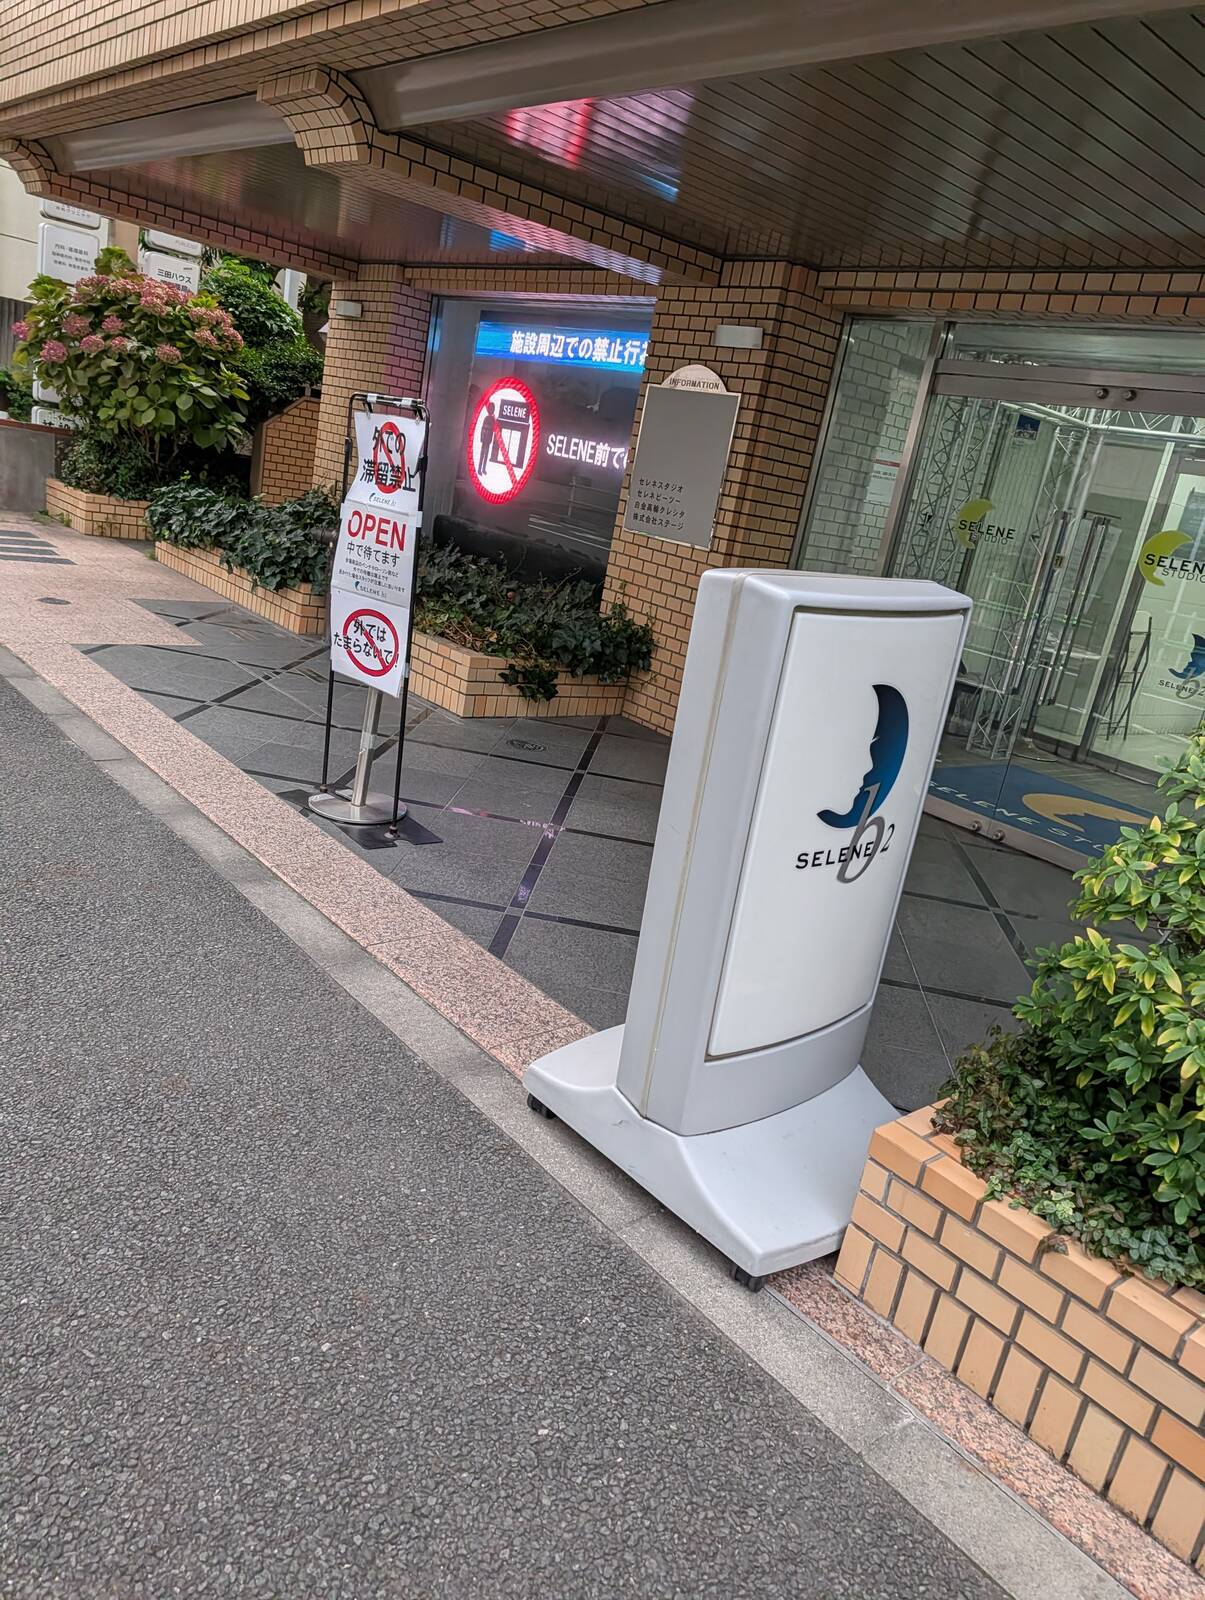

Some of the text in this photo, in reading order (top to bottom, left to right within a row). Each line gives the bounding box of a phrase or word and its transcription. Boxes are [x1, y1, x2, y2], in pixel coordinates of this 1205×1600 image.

[157, 268, 192, 284] 三田ハウス
[669, 377, 720, 391] INFORMATION
[501, 405, 527, 419] SELENE
[371, 425, 407, 456] 外での
[359, 458, 417, 493] 滞留禁止
[639, 477, 684, 493] セレネスタジオ
[347, 510, 407, 552] OPEN
[632, 512, 685, 531] 株式会社ステージ
[958, 519, 1016, 540] SELENE
[346, 542, 400, 568] 中で待てます
[353, 618, 387, 643] 外では
[795, 841, 875, 870] SELENE
